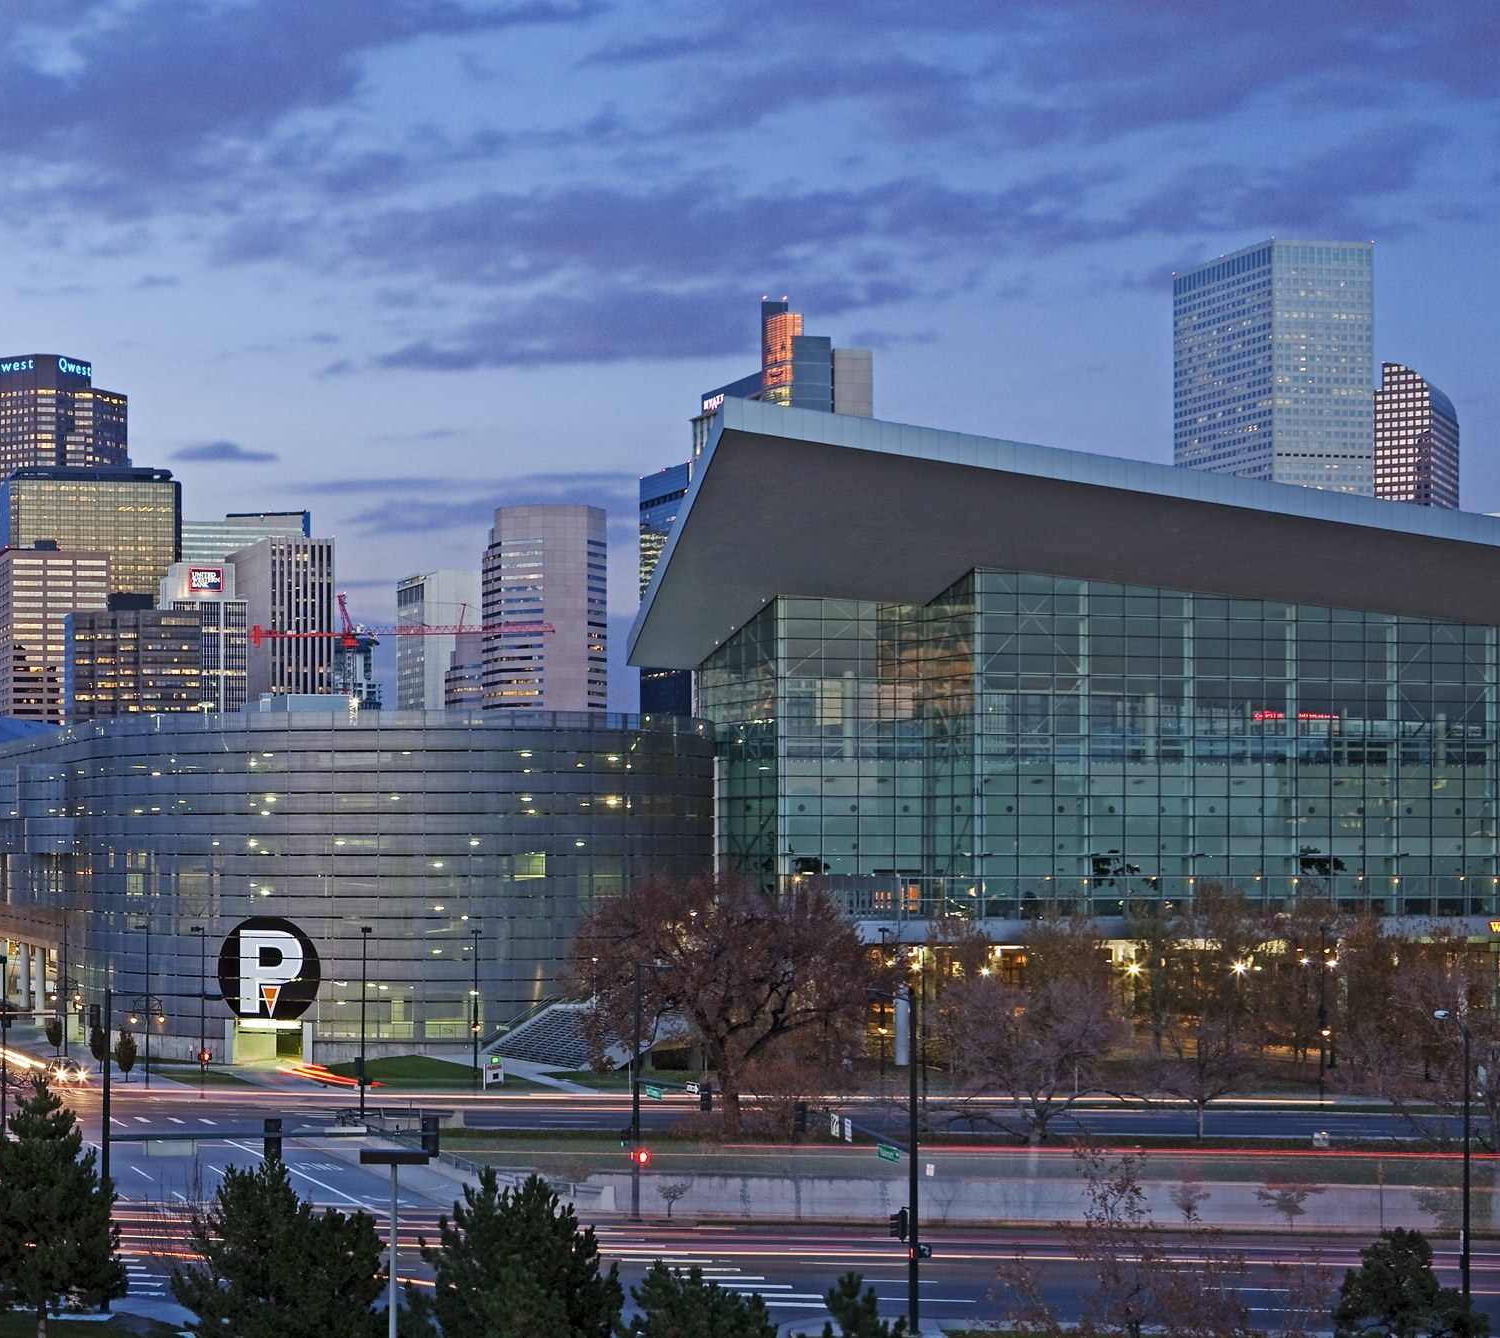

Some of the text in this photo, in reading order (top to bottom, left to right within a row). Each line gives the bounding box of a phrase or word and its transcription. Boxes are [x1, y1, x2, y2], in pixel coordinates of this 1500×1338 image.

[58, 357, 92, 377] Qwest
[703, 393, 725, 411] HYATT
[239, 929, 304, 1014] P
